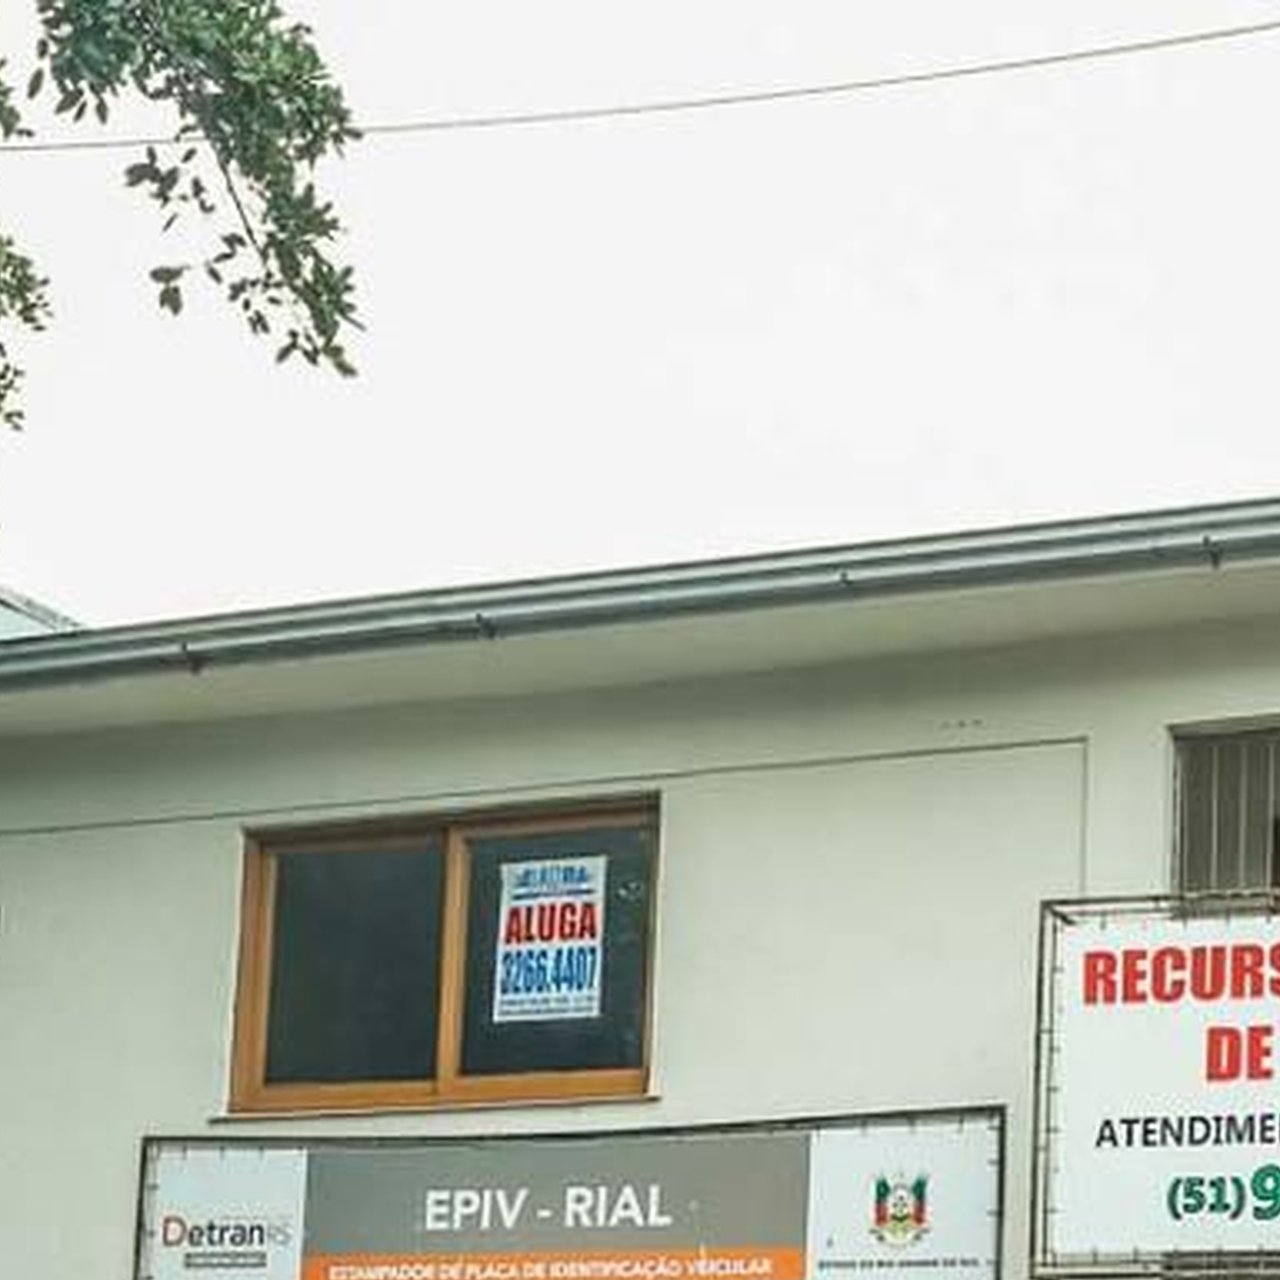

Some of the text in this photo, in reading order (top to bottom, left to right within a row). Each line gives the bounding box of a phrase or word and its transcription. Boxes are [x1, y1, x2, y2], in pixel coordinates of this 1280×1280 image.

[506, 902, 597, 943] ALUGA
[501, 947, 597, 994] 3266.4407
[1206, 1026, 1274, 1081] DE
[426, 1187, 529, 1231] EPIV
[564, 1184, 673, 1228] RIAL
